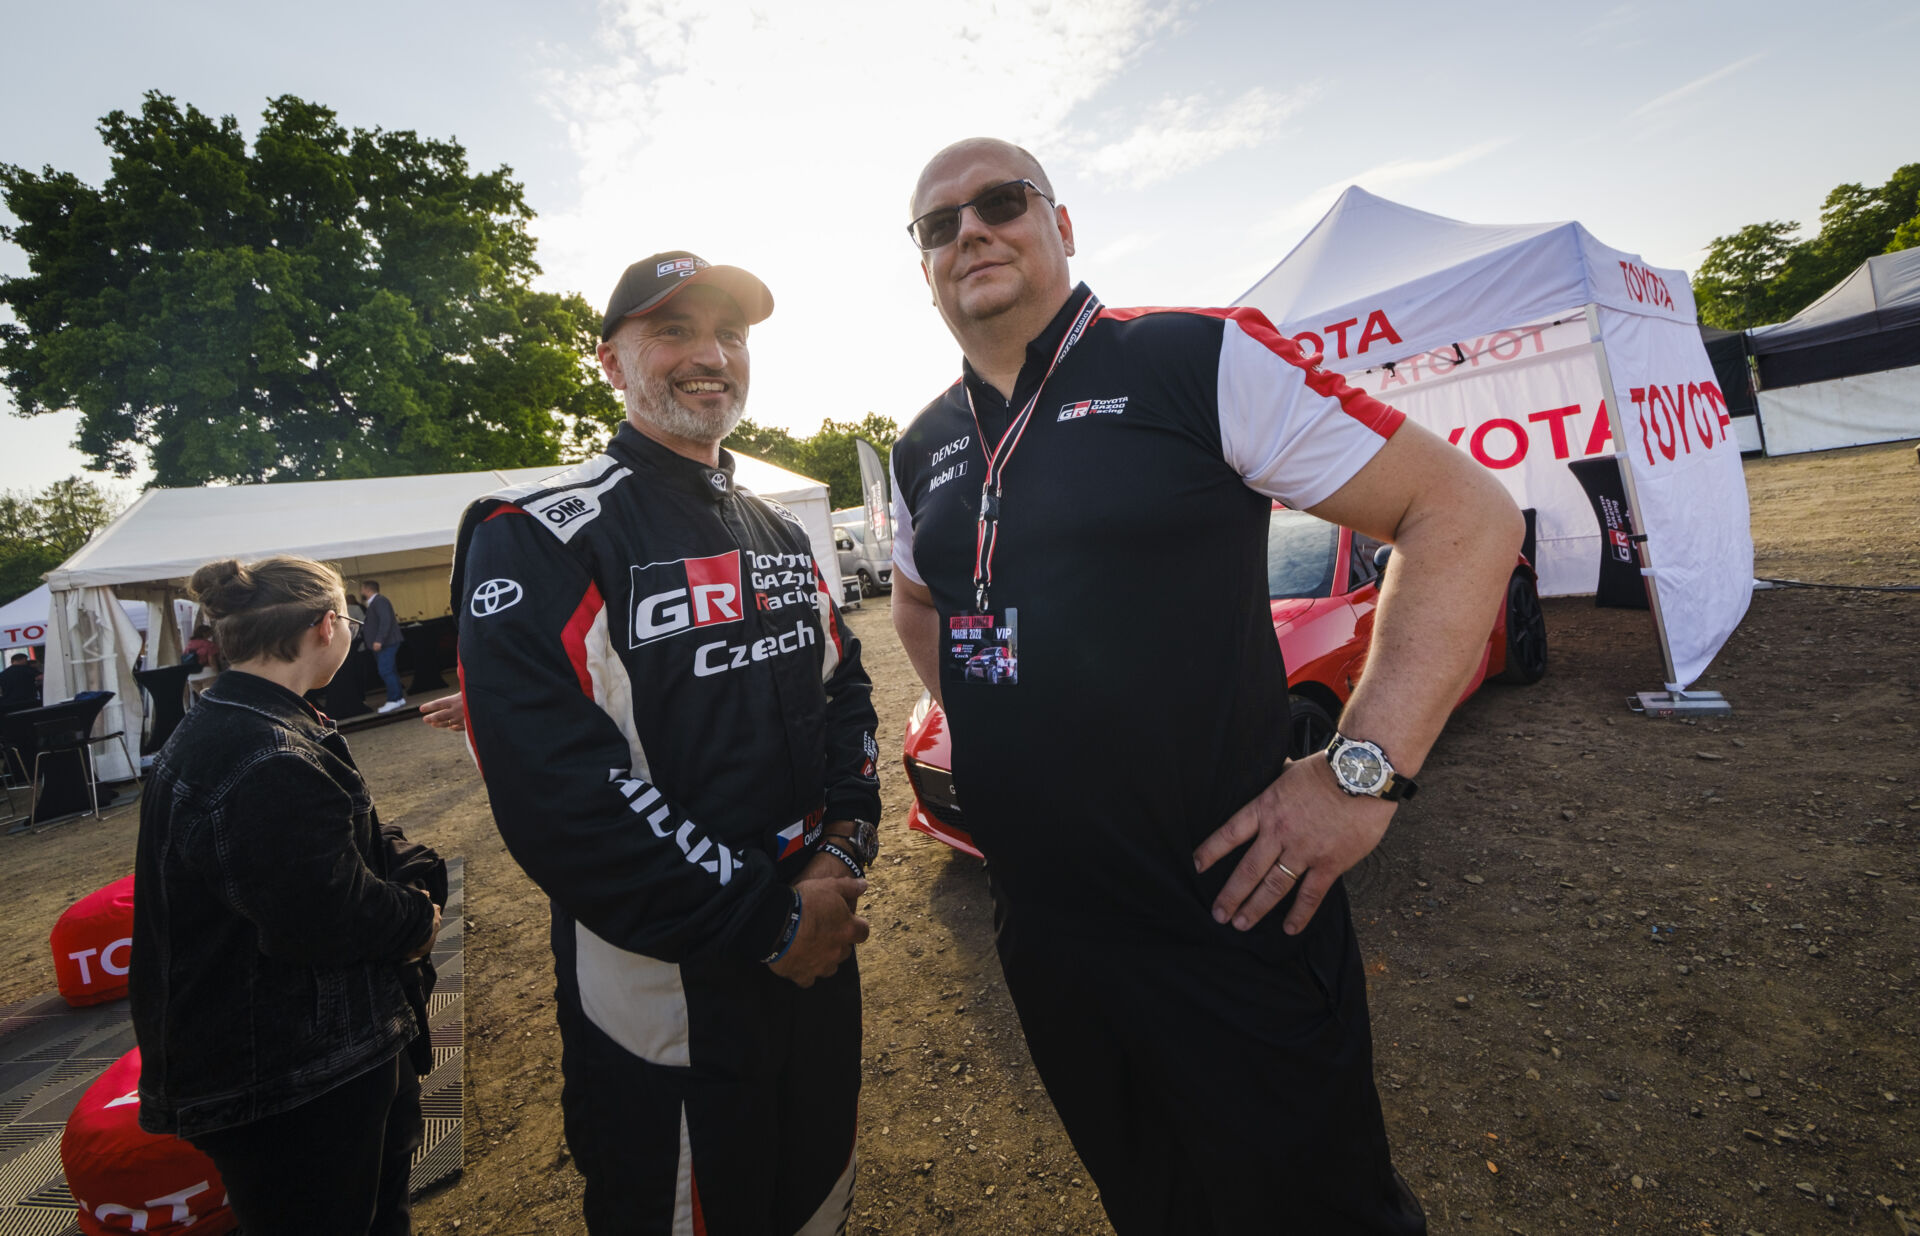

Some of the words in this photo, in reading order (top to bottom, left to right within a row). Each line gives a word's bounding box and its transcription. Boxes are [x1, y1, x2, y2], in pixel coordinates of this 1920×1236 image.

[659, 261, 691, 273] GR
[1619, 261, 1674, 312] TOYOTA
[1075, 308, 1091, 334] TOYOTA
[1292, 309, 1403, 360] OTA
[1059, 406, 1088, 420] GR
[1093, 396, 1128, 405] TOYOTA
[1629, 380, 1730, 466] TOYOTA
[931, 435, 970, 467] DENSO
[928, 466, 955, 493] Mobil
[546, 498, 586, 523] OMP
[1615, 532, 1630, 561] GR
[635, 582, 739, 640] GR
[755, 586, 819, 611] Racing
[996, 627, 1012, 640] VIP
[693, 620, 815, 677] Czech
[825, 844, 862, 878] TOYOTA
